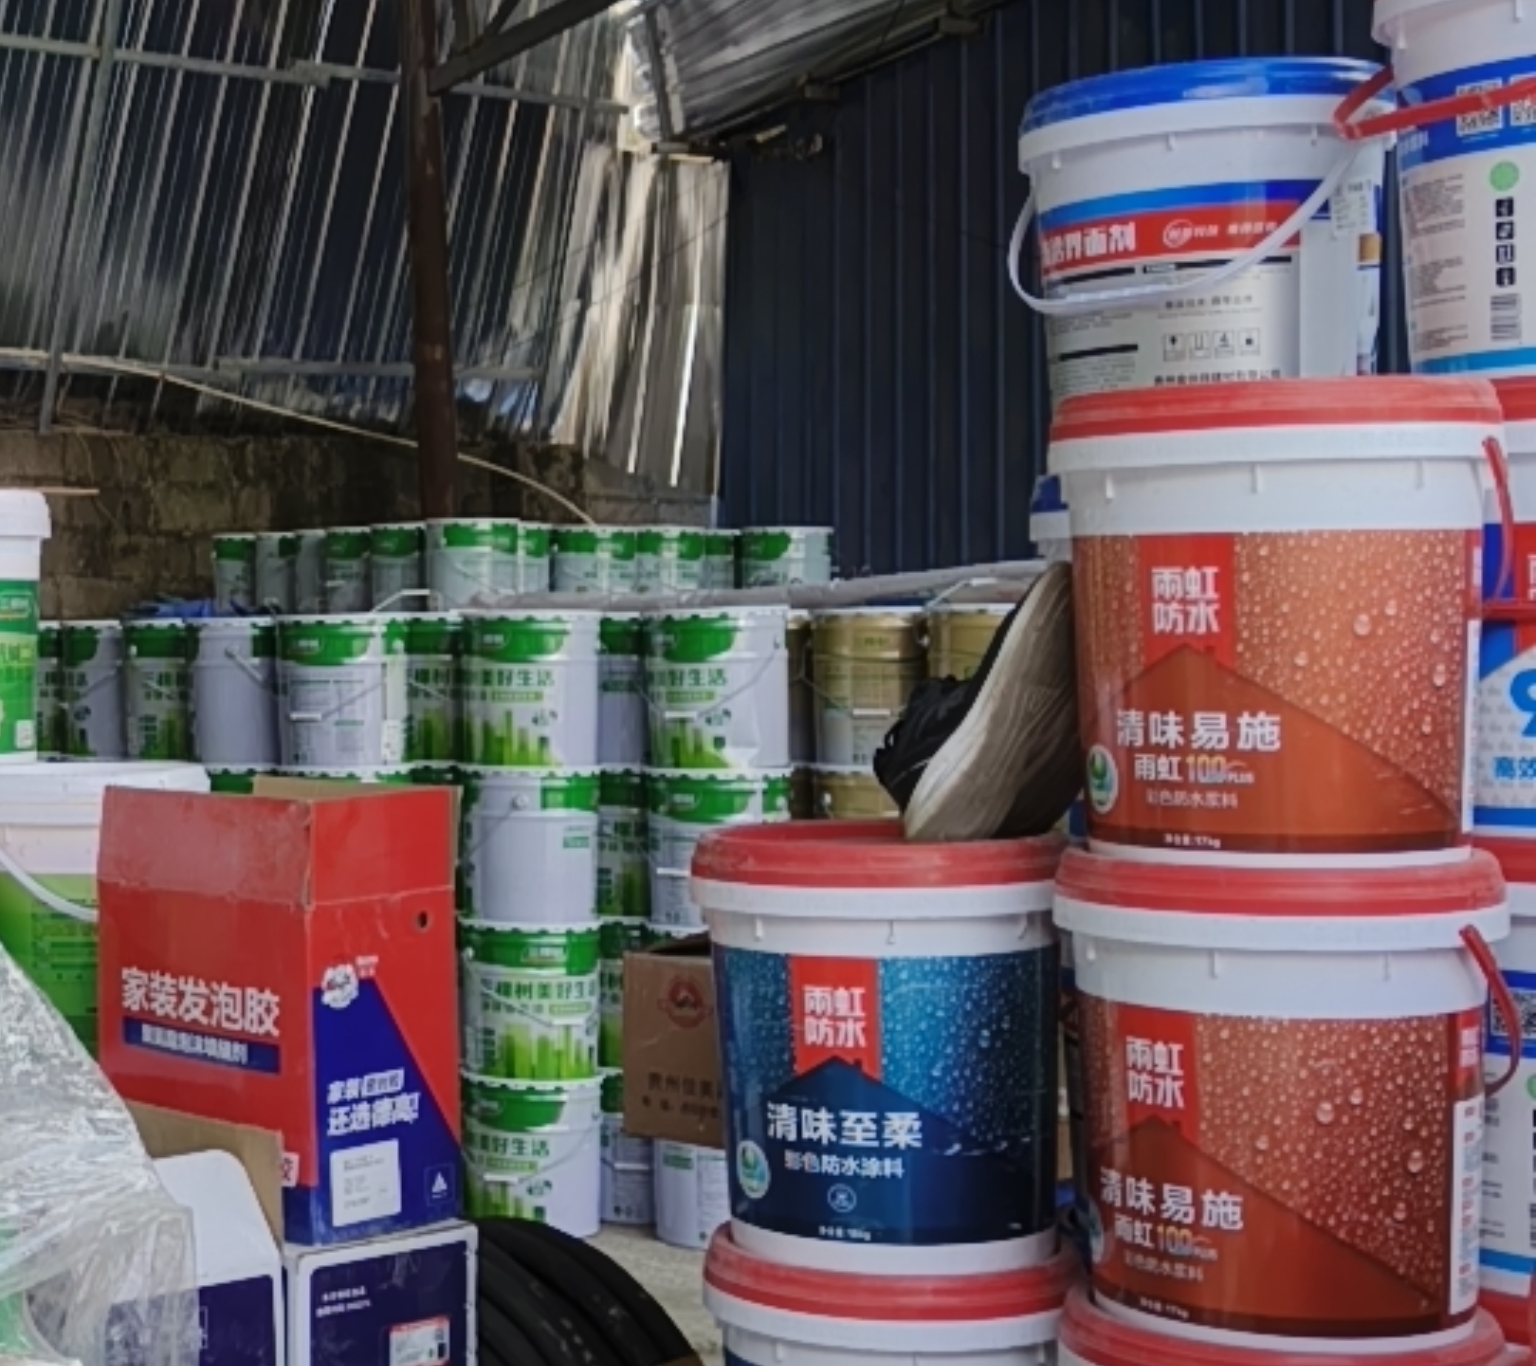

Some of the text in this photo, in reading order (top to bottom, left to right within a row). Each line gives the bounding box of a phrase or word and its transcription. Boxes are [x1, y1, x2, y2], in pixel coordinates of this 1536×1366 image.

[1151, 566, 1219, 599] 雨虹
[1152, 601, 1220, 634] 防水
[1117, 710, 1280, 751] 清味易施
[121, 966, 280, 1036] 家装发泡胶
[804, 986, 865, 1017] 雨虹
[804, 1018, 865, 1048] 防水
[1126, 1037, 1183, 1076] 雨虹
[1128, 1073, 1184, 1109] 防水
[767, 1103, 922, 1148] 清味至柔
[1100, 1167, 1243, 1230] 清味易施
